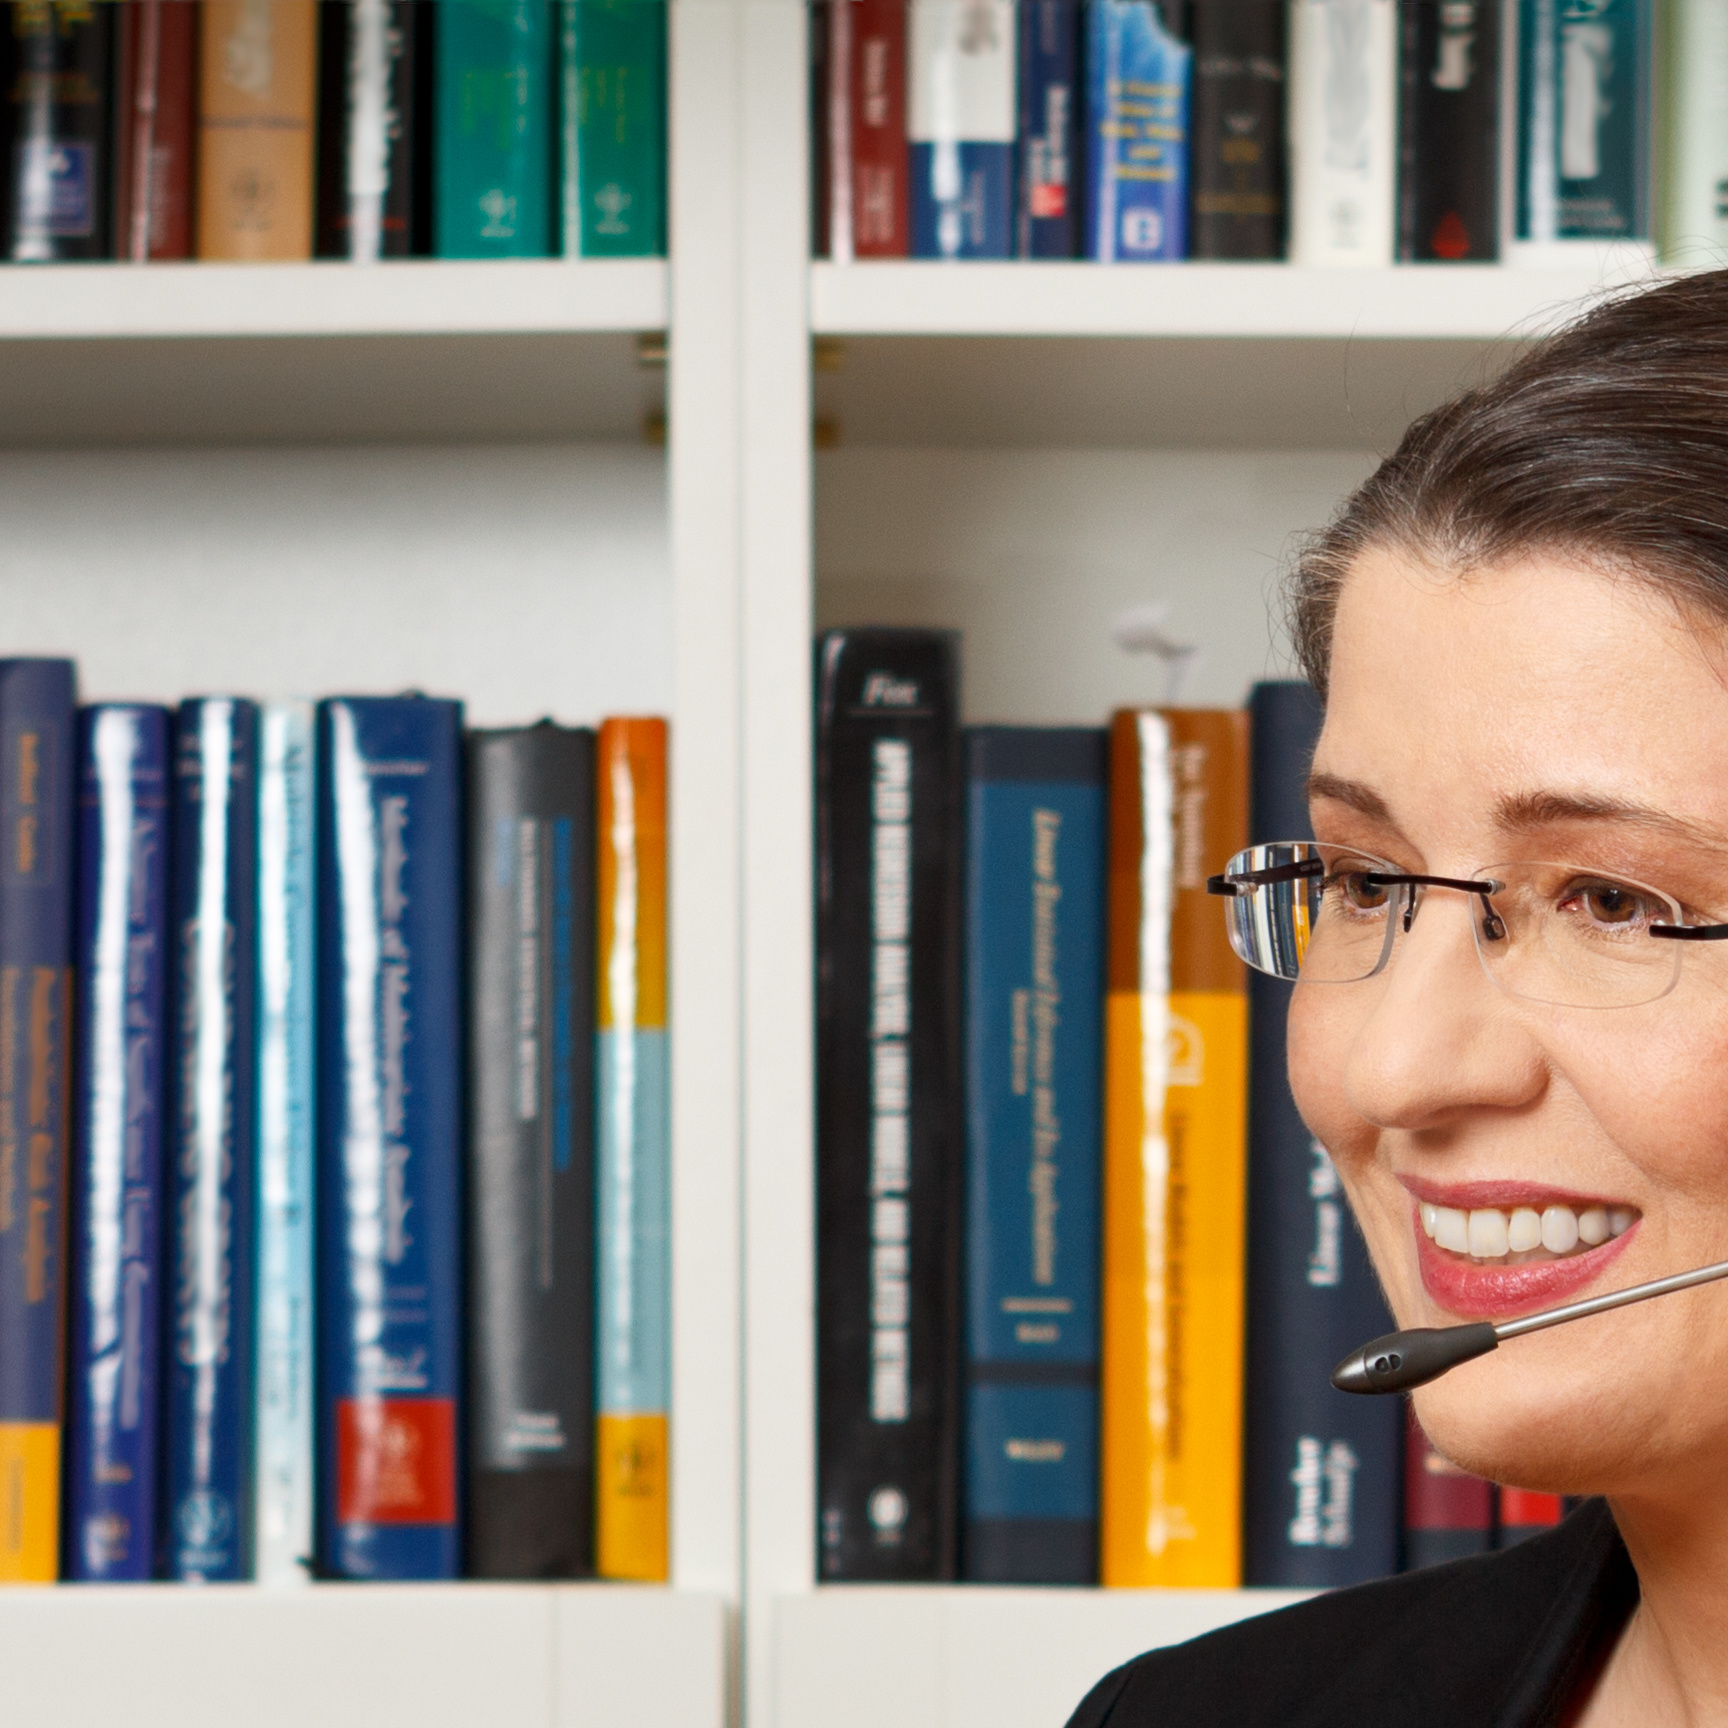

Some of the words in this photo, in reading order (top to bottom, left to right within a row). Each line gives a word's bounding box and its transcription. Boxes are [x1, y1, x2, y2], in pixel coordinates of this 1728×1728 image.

[862, 670, 918, 707] Fox
[871, 739, 911, 823] APPLIED
[381, 797, 410, 926] Methods
[871, 826, 911, 943] REGRESSION
[1031, 811, 1063, 883] Linear
[382, 929, 410, 963] of
[1031, 884, 1063, 986] Statistical
[871, 945, 911, 1041] ANALYSIS,
[1031, 988, 1062, 1086] Inference
[29, 968, 57, 1127] Probabilistic
[382, 965, 410, 1138] Multivariate
[871, 1043, 911, 1112] LINEAR
[1032, 1088, 1058, 1128] and
[29, 1133, 54, 1191] Risk
[871, 1115, 911, 1198] MODELS,
[381, 1144, 409, 1264] Analysis
[871, 1200, 911, 1243] AND
[1027, 1160, 1059, 1286] Applications
[1308, 1201, 1341, 1287] Linear
[24, 1196, 53, 1304] Analysis
[871, 1245, 911, 1326] RELATED
[871, 1329, 911, 1423] METHODS
